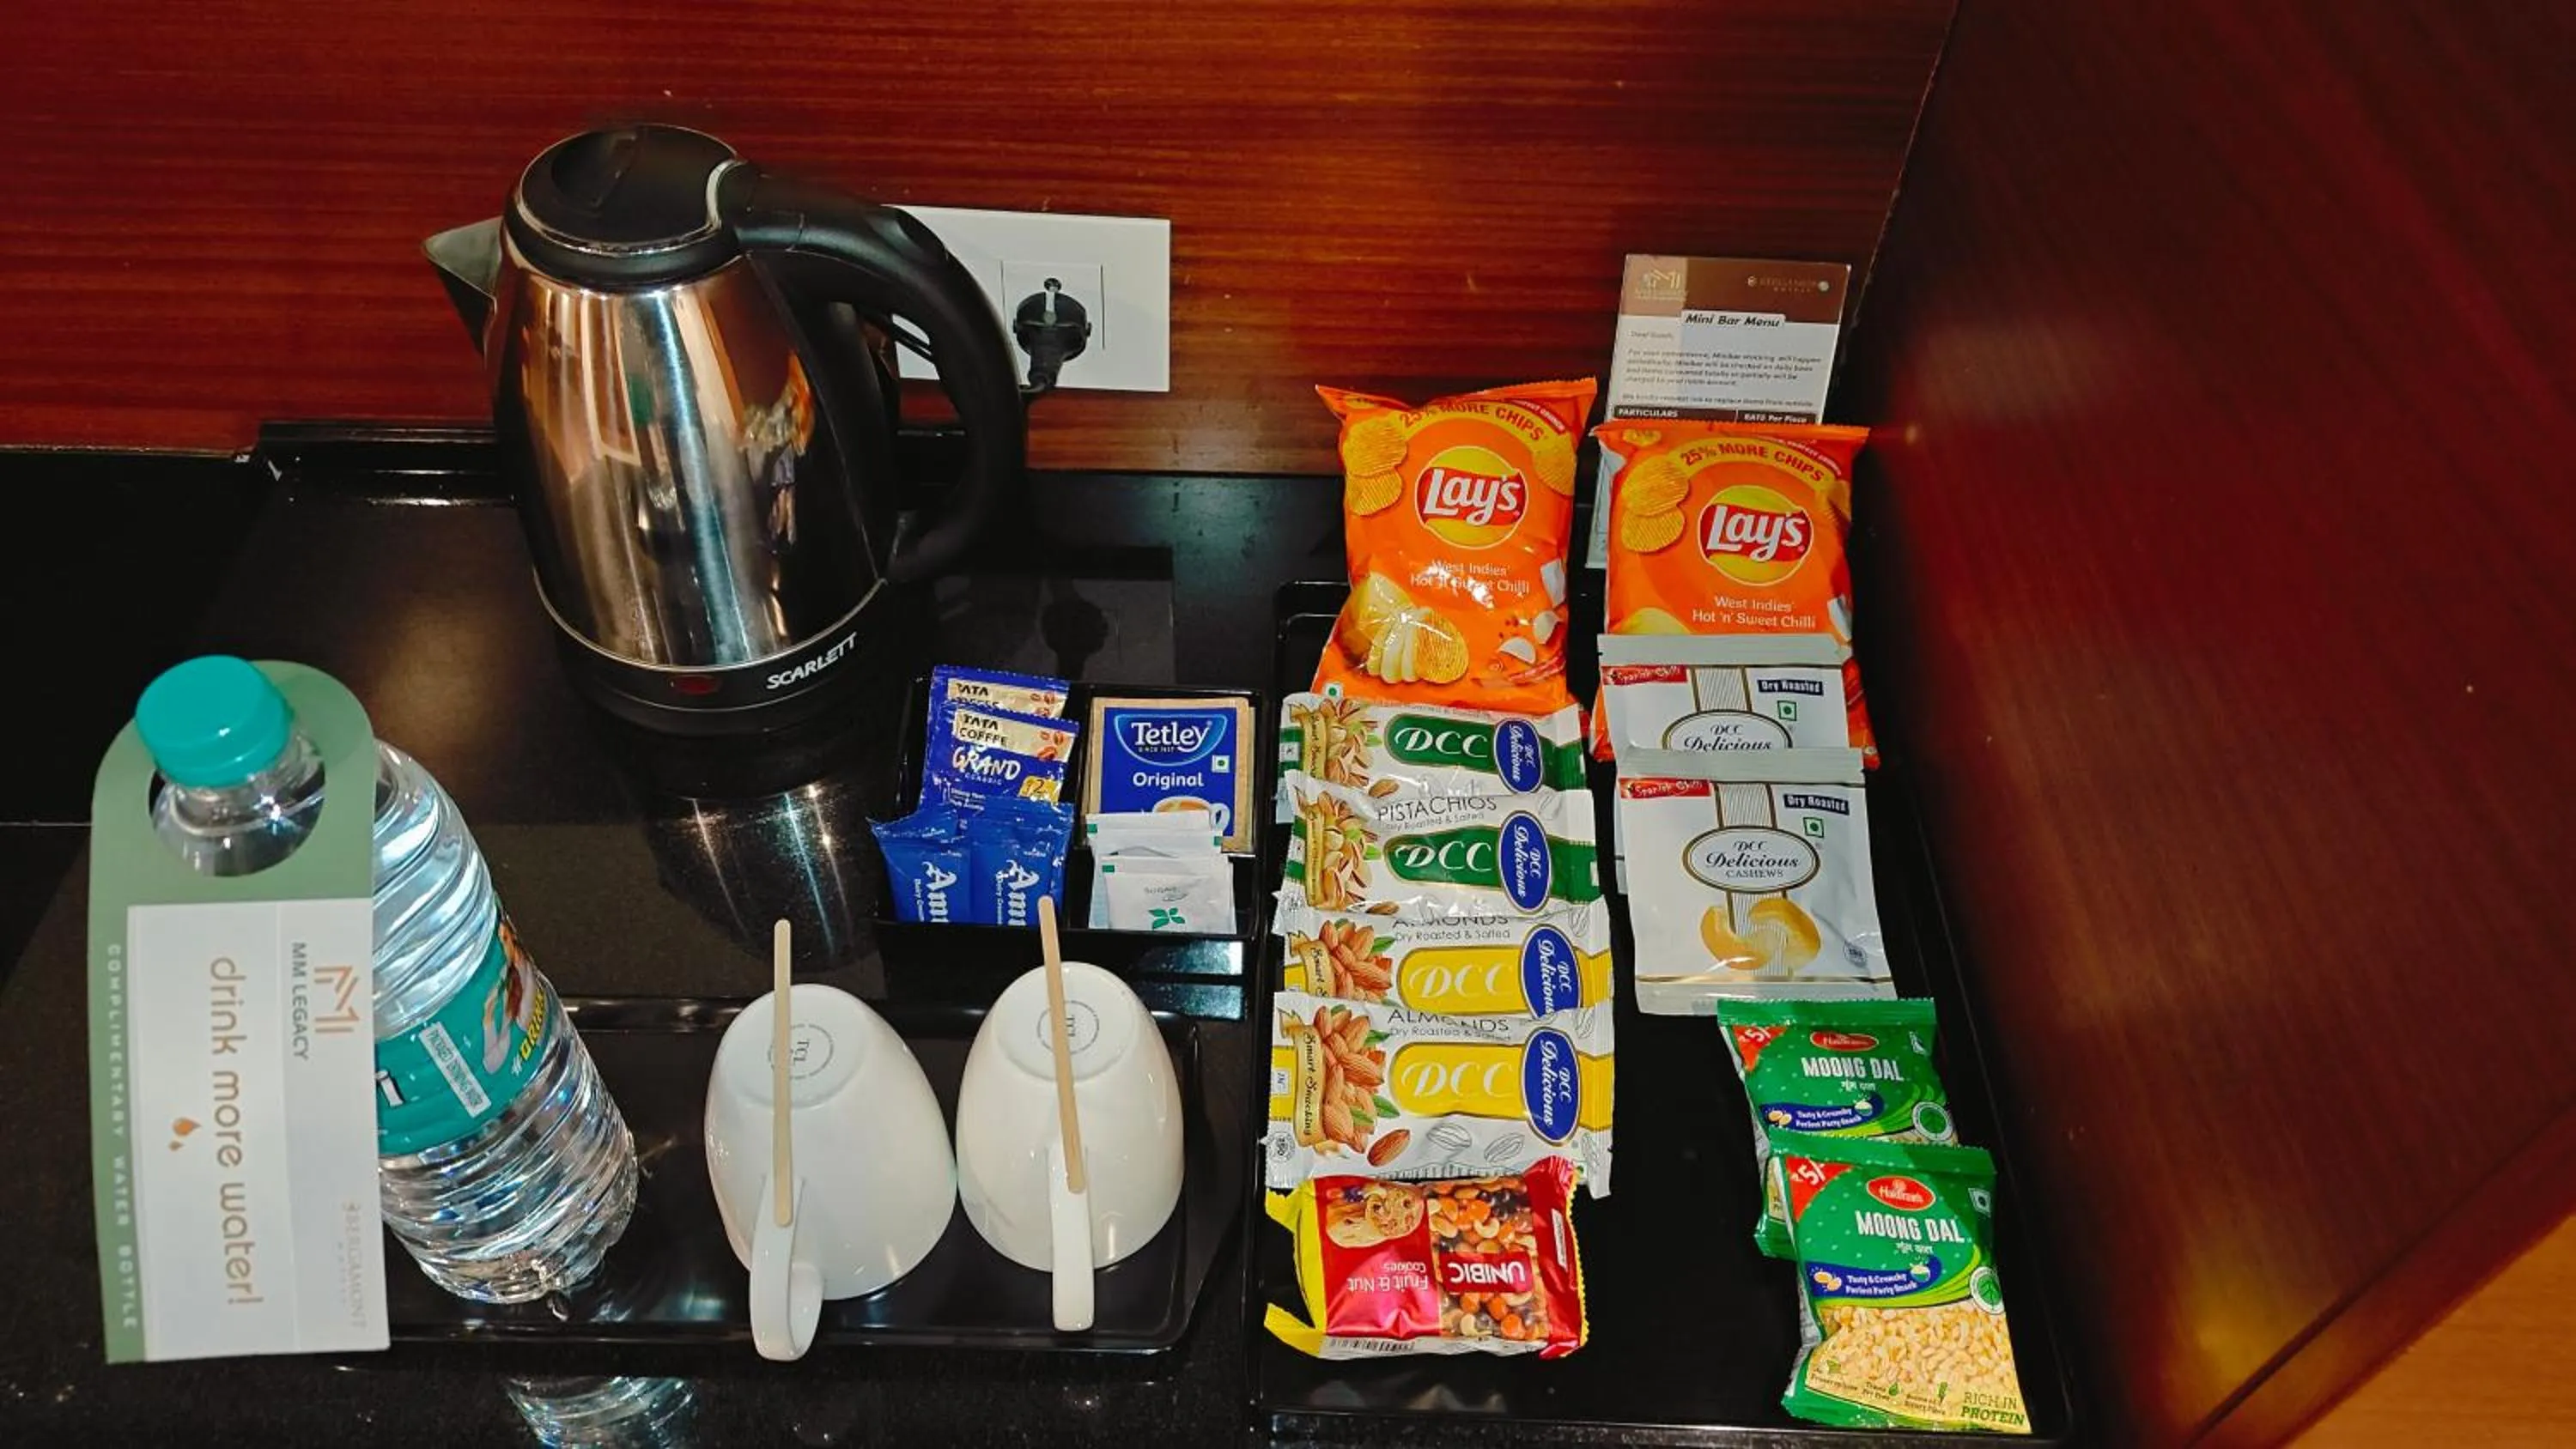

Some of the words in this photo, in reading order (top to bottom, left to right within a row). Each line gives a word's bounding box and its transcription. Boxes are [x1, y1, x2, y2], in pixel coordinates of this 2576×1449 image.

[1686, 314, 1713, 325] Mini
[1717, 316, 1741, 325] Bar
[1744, 317, 1780, 327] Menu
[1495, 407, 1545, 440] CHIPS
[1619, 409, 1678, 418] PARTICULARS
[1718, 443, 1769, 458] MORE
[1774, 451, 1825, 482] CHIPS
[1423, 468, 1522, 527] Lay's
[1706, 505, 1805, 562] Lay's
[1497, 579, 1530, 594] Chilli
[1715, 596, 1748, 609] West
[1692, 609, 1716, 622] Hot
[1737, 612, 1780, 627] Sweet
[1781, 615, 1817, 629] Chilli
[766, 632, 857, 689] SCARLETT
[956, 682, 988, 696] TATA
[963, 713, 999, 730] TATA
[1131, 721, 1211, 753] Tetley
[1394, 726, 1489, 759] DCC
[1509, 724, 1523, 784] Delicious
[1684, 736, 1772, 750] Delicious
[952, 746, 1021, 780] GRAND
[1133, 772, 1205, 791] Original
[1377, 796, 1498, 822] PISTACHIOS
[1786, 795, 1805, 808] Dry
[1807, 797, 1847, 813] Roasted
[1394, 840, 1492, 872] DCC
[1514, 824, 1529, 899] Delicious
[1705, 852, 1800, 869] Delicious
[1733, 840, 1769, 852] DCC
[1529, 846, 1542, 879] DCC
[1725, 868, 1784, 879] CASHEWS
[1394, 931, 1412, 943] Dry
[1416, 930, 1460, 941] Roasted
[1464, 931, 1473, 939] &
[1475, 928, 1511, 939] Salted
[291, 942, 307, 978] MM
[1409, 962, 1514, 998] DCC
[1538, 939, 1556, 1017] Delicious
[1557, 961, 1572, 993] DCC
[210, 955, 246, 1056] drink
[293, 980, 309, 1061] LEGACY
[106, 943, 125, 1138] COMPLIMENTARY
[1302, 1032, 1316, 1074] Smart
[1400, 1062, 1515, 1099] DCC
[1540, 1040, 1558, 1127] Delicious
[1558, 1067, 1572, 1103] DCC
[1801, 1056, 1866, 1079] MOONG
[1869, 1058, 1905, 1082] DAL
[213, 1069, 244, 1169] more
[112, 1155, 130, 1227] WATER
[219, 1179, 264, 1307] water!
[1855, 1210, 1923, 1241] MOONG
[1925, 1218, 1965, 1244] DAL
[1383, 1261, 1426, 1274] Cookies
[1392, 1274, 1429, 1293] Fruit
[1448, 1261, 1526, 1284] UNIBIC
[118, 1243, 138, 1329] BOTTLE
[1346, 1276, 1376, 1293] Nut
[1960, 1405, 2025, 1426] PROTEIN
[1964, 1391, 1999, 1408] RICH
[2002, 1396, 2018, 1410] IN
